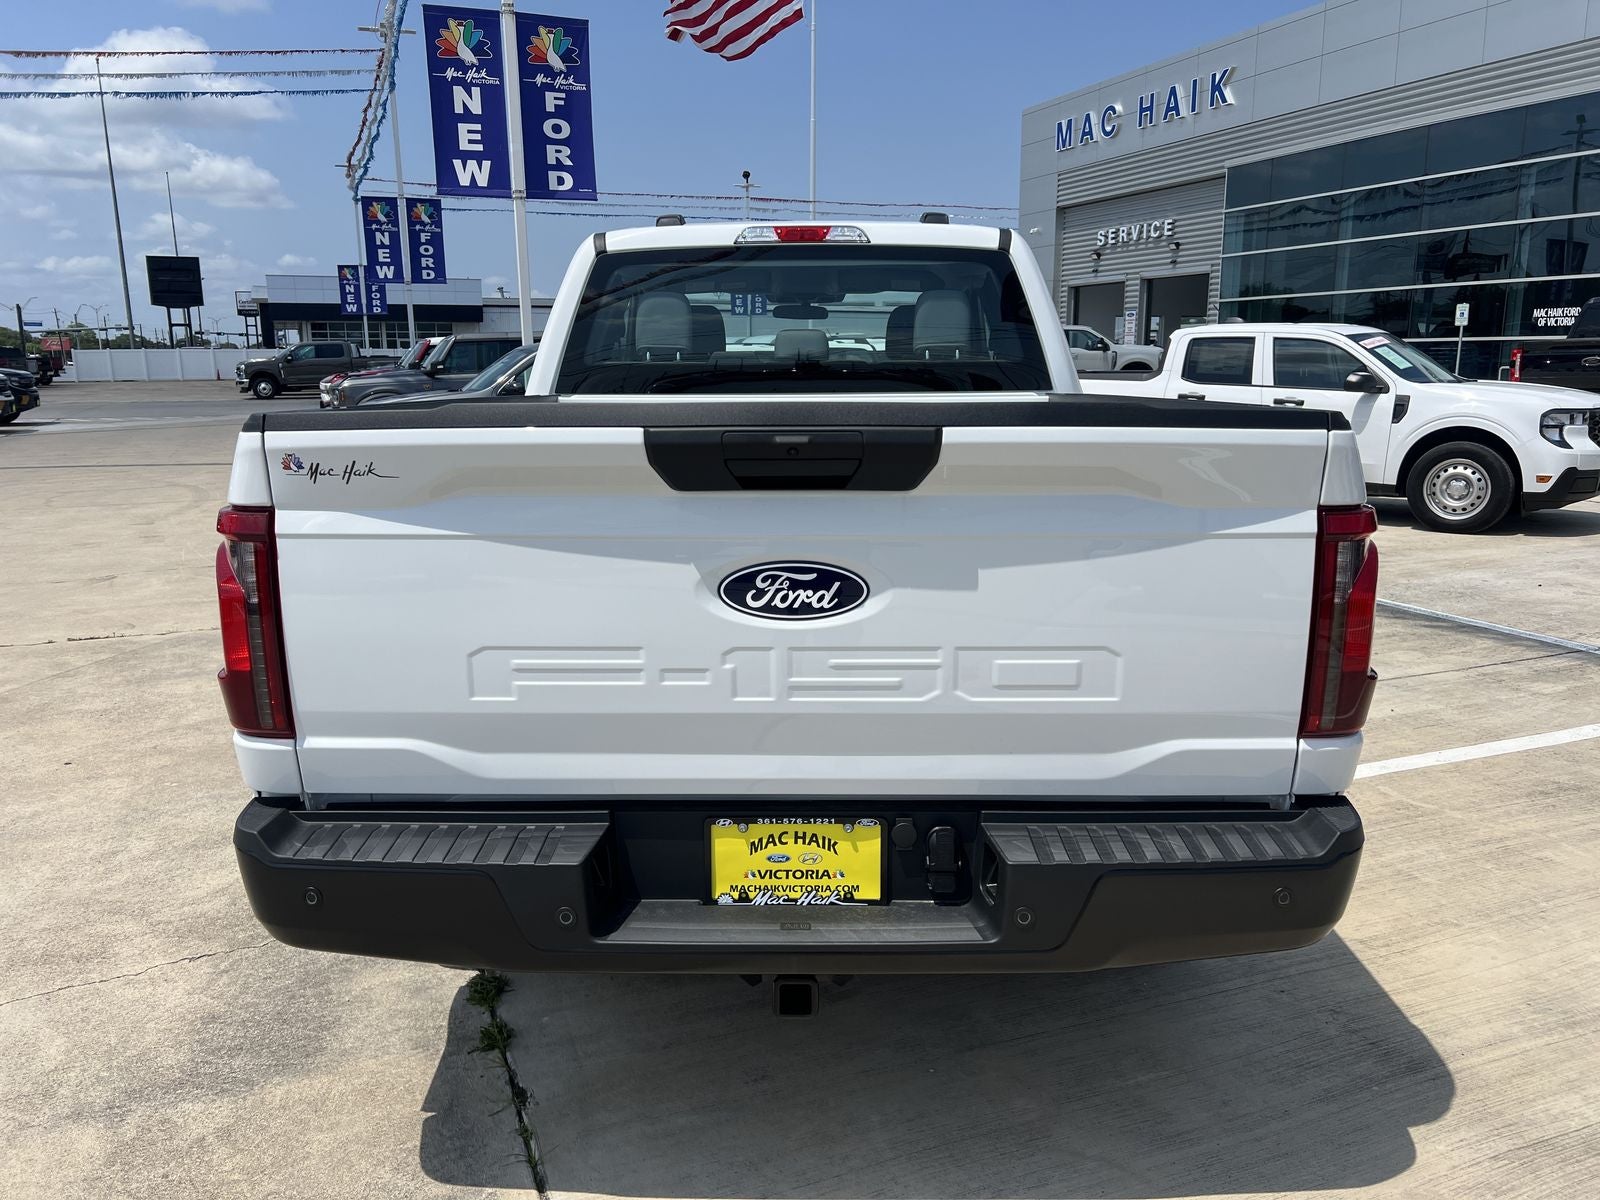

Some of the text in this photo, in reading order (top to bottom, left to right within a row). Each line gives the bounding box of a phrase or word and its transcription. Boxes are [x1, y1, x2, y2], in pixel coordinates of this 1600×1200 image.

[434, 67, 498, 83] Mac Haik
[525, 73, 586, 89] Mac Haik
[1055, 66, 1235, 152] MAC HAIK
[452, 86, 491, 188] NEW
[543, 91, 574, 192] FORD
[1096, 219, 1174, 246] SERVICE
[375, 232, 394, 279] NEW
[420, 233, 435, 280] FORD
[345, 285, 357, 312] NEW
[371, 285, 381, 313] FORD
[1532, 306, 1582, 318] MAC HAIK FORD
[1537, 316, 1575, 327] OF VICTORIA
[298, 460, 391, 485] Mac Haik
[745, 570, 841, 609] Ford
[466, 645, 1122, 702] F-150
[757, 817, 836, 825] 361-576-1221
[749, 830, 840, 857] MAC HAIK
[757, 869, 832, 880] VICTORIA
[750, 889, 848, 906] Mac Haik
